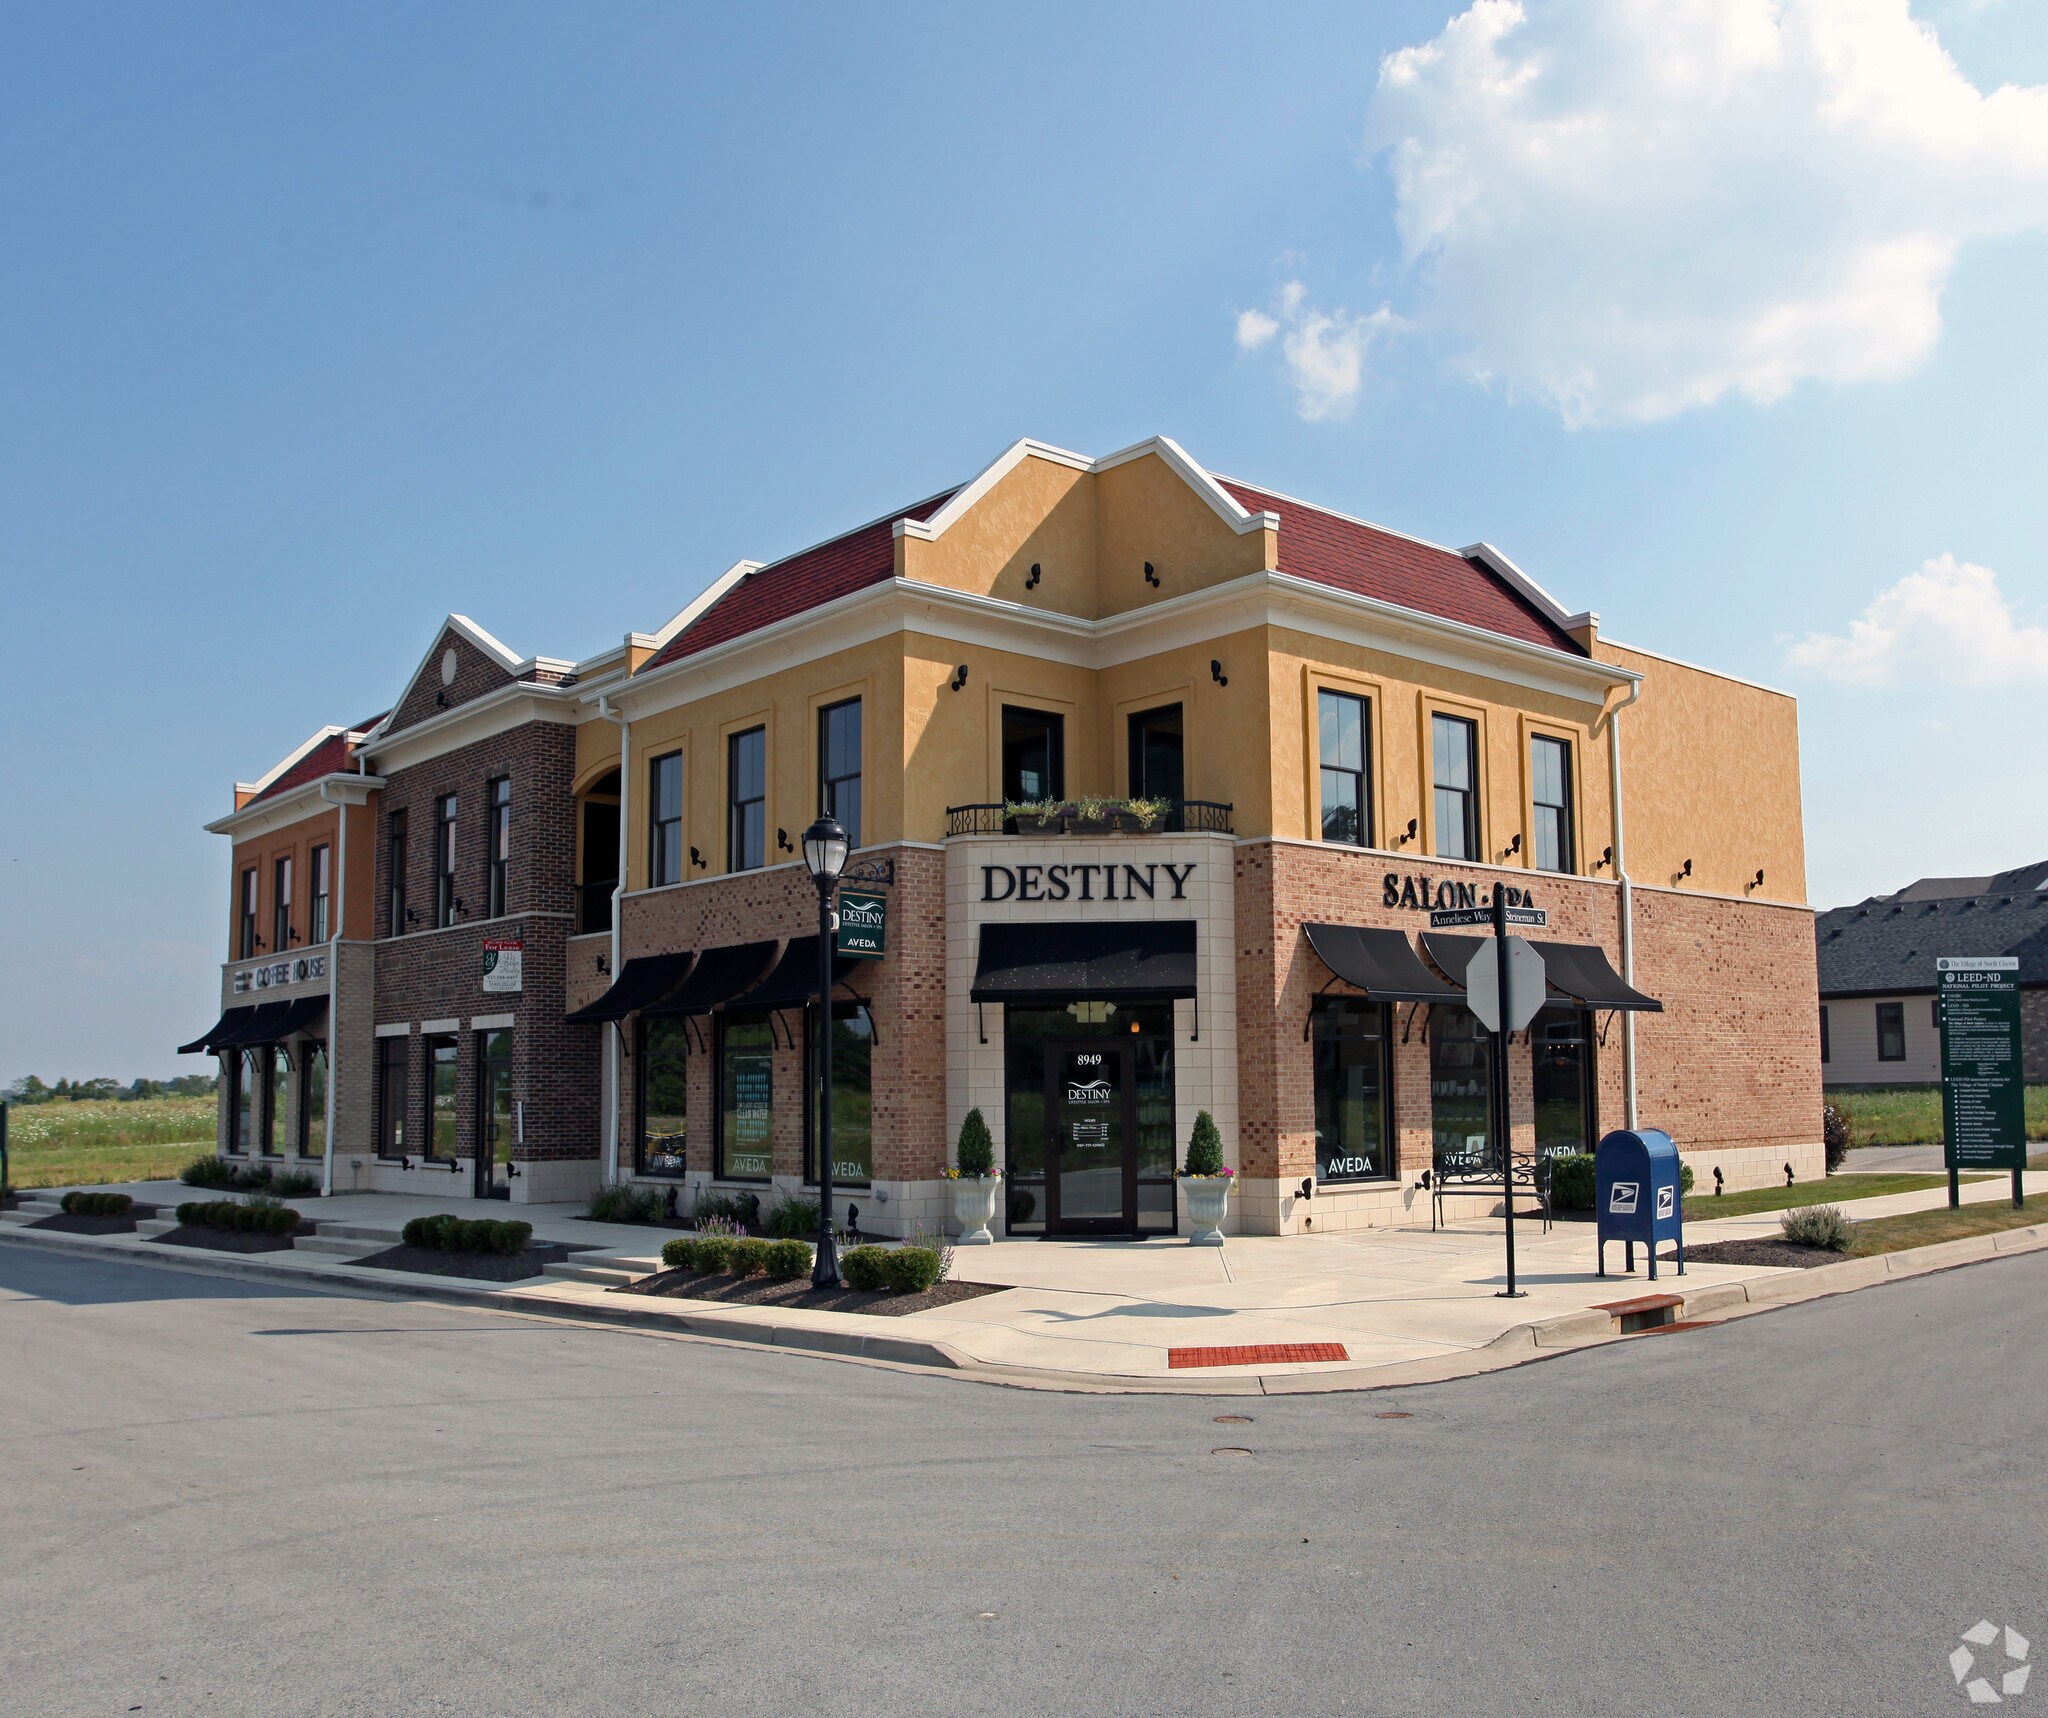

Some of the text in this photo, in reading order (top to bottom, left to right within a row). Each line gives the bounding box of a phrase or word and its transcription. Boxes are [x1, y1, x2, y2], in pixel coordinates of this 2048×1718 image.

[981, 864, 1197, 901] DESTINY
[1383, 872, 1535, 910] SALON PA
[842, 909, 885, 924] DESTINY
[1432, 911, 1492, 926] Anneliese Way
[1505, 910, 1535, 924] Steineman
[847, 938, 877, 948] AVEDA
[1951, 960, 1960, 968] The
[1960, 960, 1977, 968] Village
[1998, 960, 2016, 968] Clayton
[256, 963, 290, 988] COFFEE
[292, 956, 325, 982] HOUSE
[1957, 973, 2001, 982] LEED-ND
[1077, 1054, 1102, 1066] 8949
[1068, 1088, 1112, 1100] DESTINY
[736, 1108, 768, 1120] CLEAN WATER
[1543, 1146, 1577, 1159] AVEDA
[733, 1158, 767, 1172] AVEDA
[1328, 1156, 1373, 1174] AVEDA
